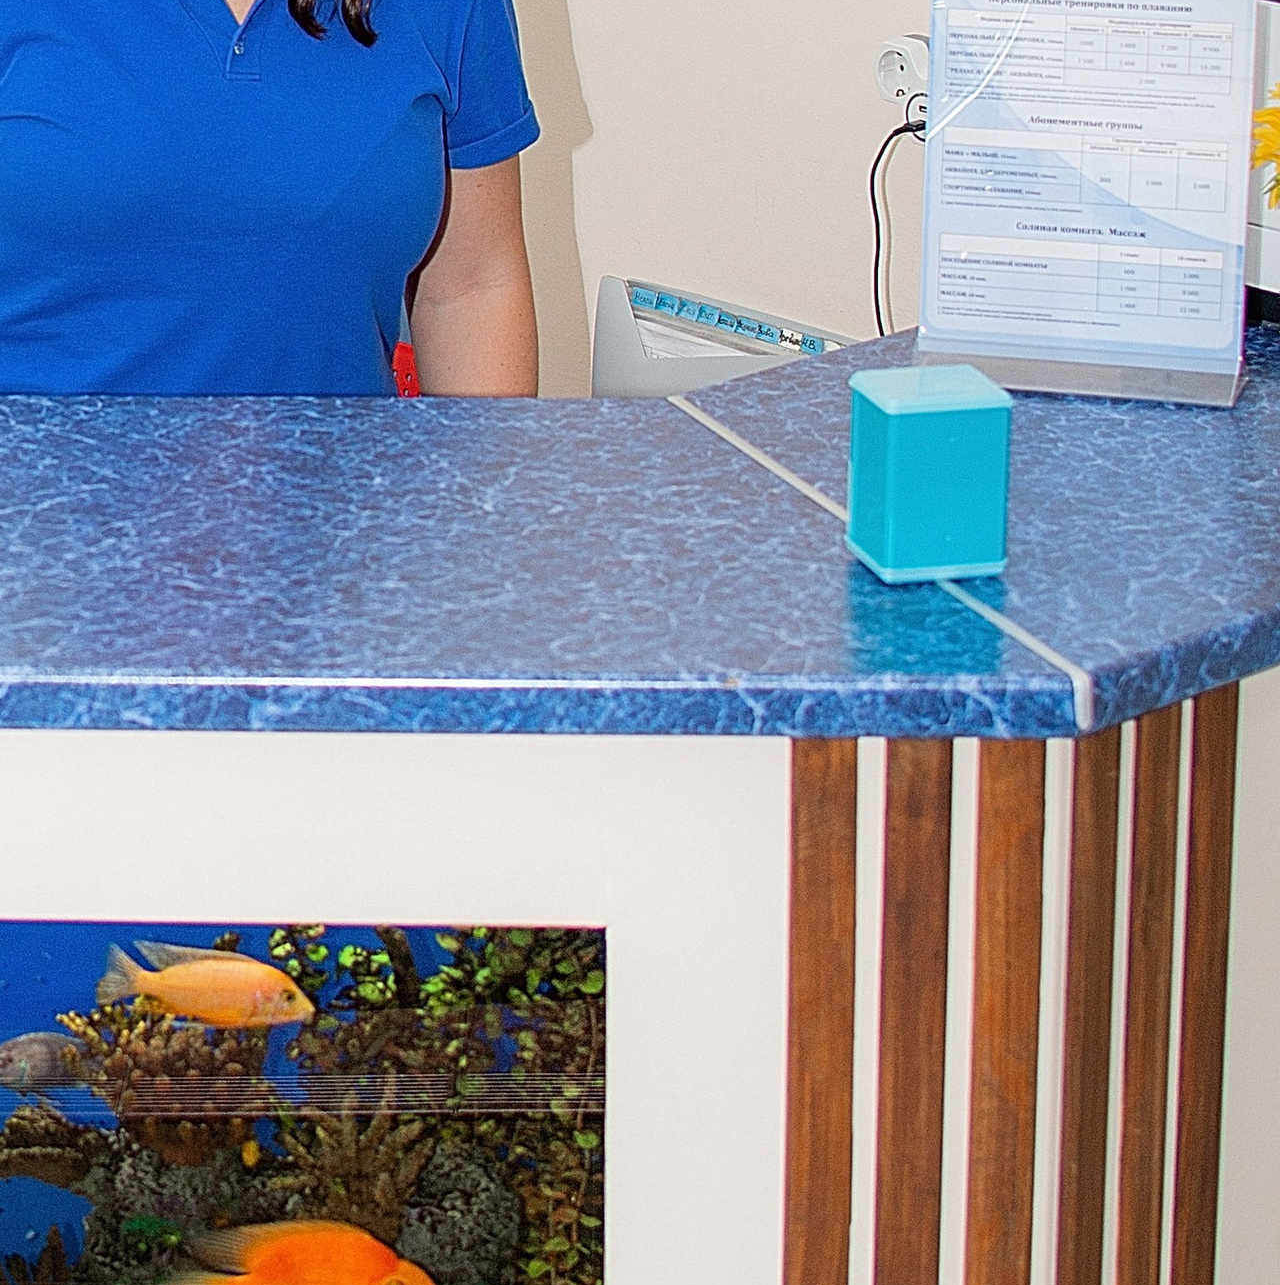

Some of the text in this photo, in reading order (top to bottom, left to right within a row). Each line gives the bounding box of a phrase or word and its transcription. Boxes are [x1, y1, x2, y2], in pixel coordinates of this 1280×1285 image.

[1126, 2, 1139, 11] по
[1141, 4, 1193, 13] плаванию
[1028, 115, 1143, 130] Абонементные группы
[1016, 222, 1146, 238] Соляная комната. Массаж
